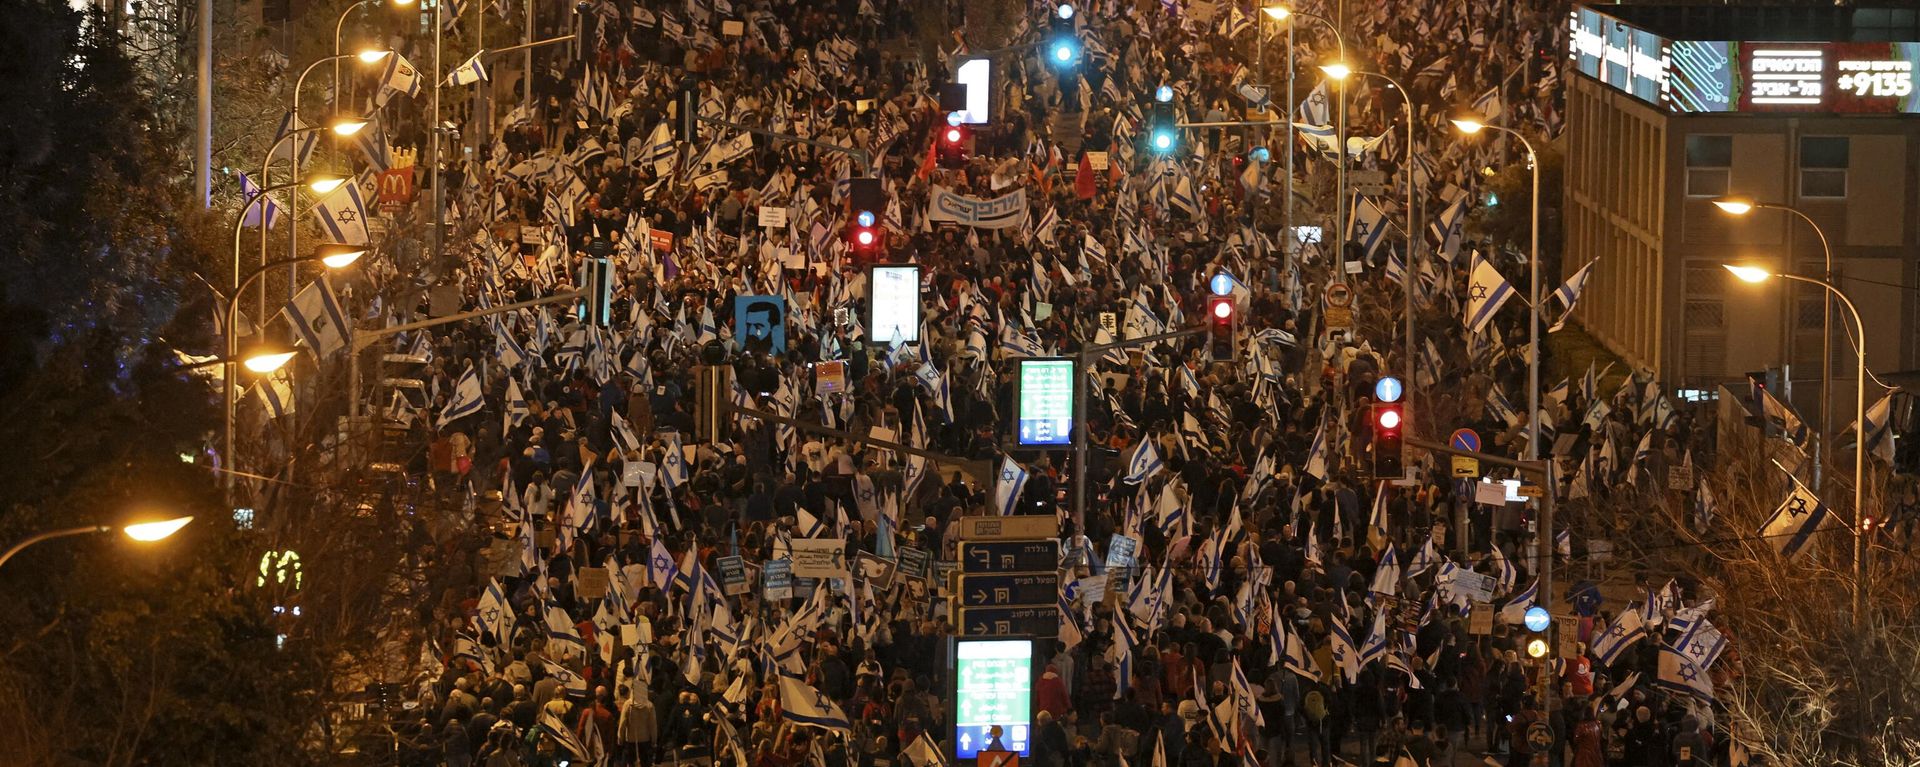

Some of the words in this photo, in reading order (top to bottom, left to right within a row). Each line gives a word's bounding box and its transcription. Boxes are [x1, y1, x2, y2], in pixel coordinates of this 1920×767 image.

[1752, 81, 1821, 96] תל-אביב
[1024, 545, 1048, 553] גולדה
[1036, 576, 1056, 584] מפעל
[1011, 609, 1035, 618] לסקוב
[1038, 609, 1056, 618] חניון
